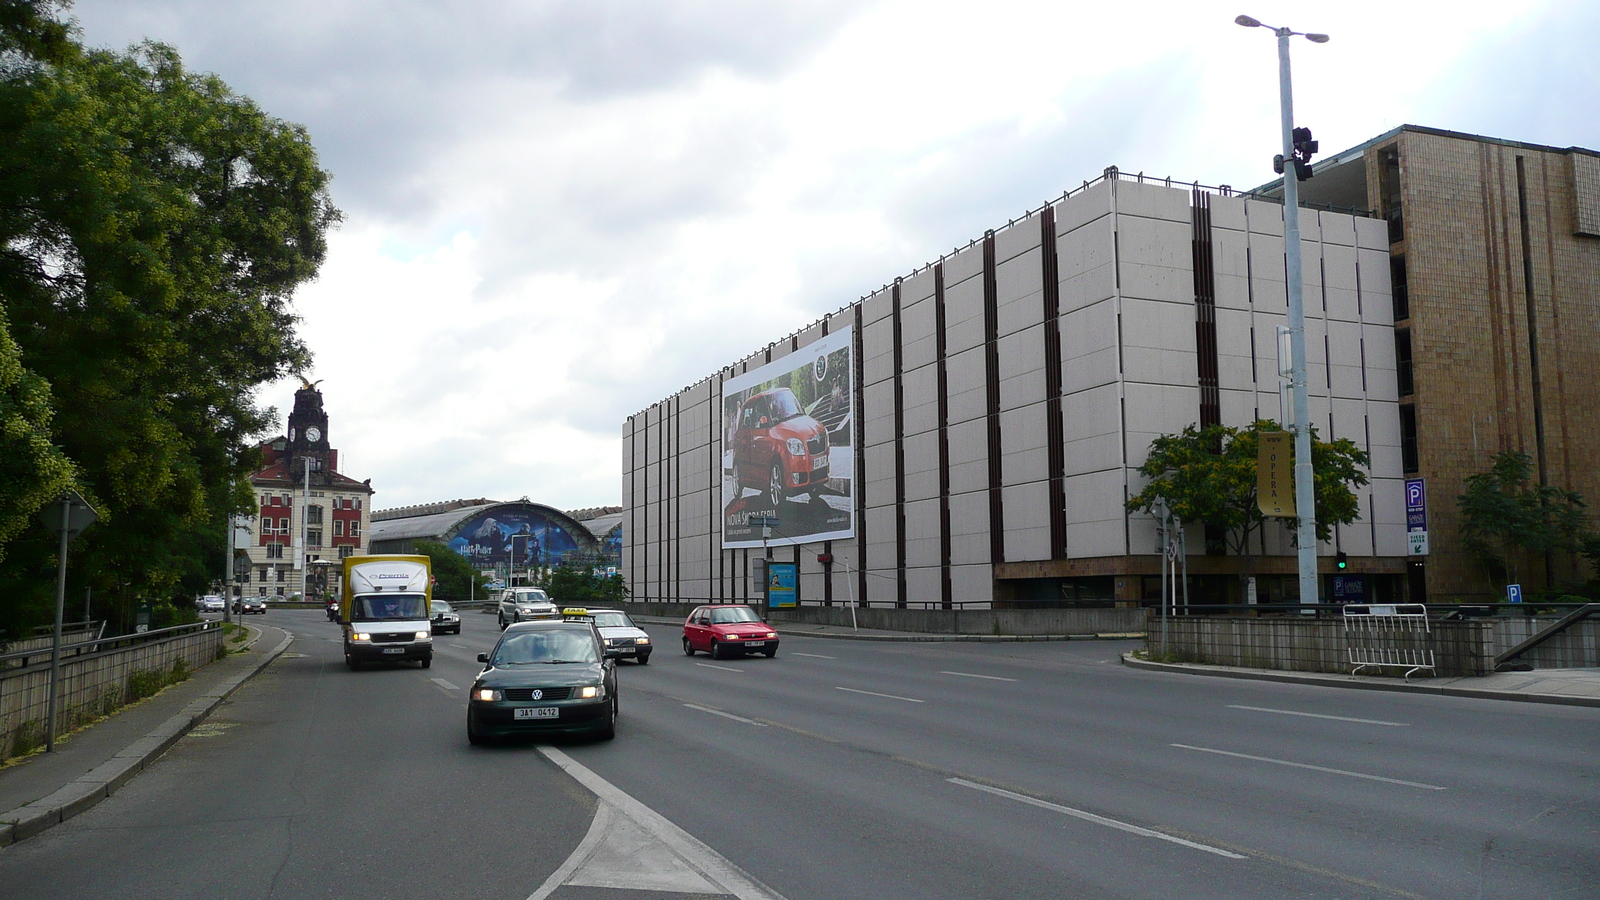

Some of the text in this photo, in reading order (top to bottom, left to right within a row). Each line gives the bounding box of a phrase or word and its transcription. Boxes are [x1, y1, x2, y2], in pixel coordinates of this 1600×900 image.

[1410, 489, 1420, 504] P
[1510, 587, 1518, 601] P
[538, 708, 556, 716] 0412
